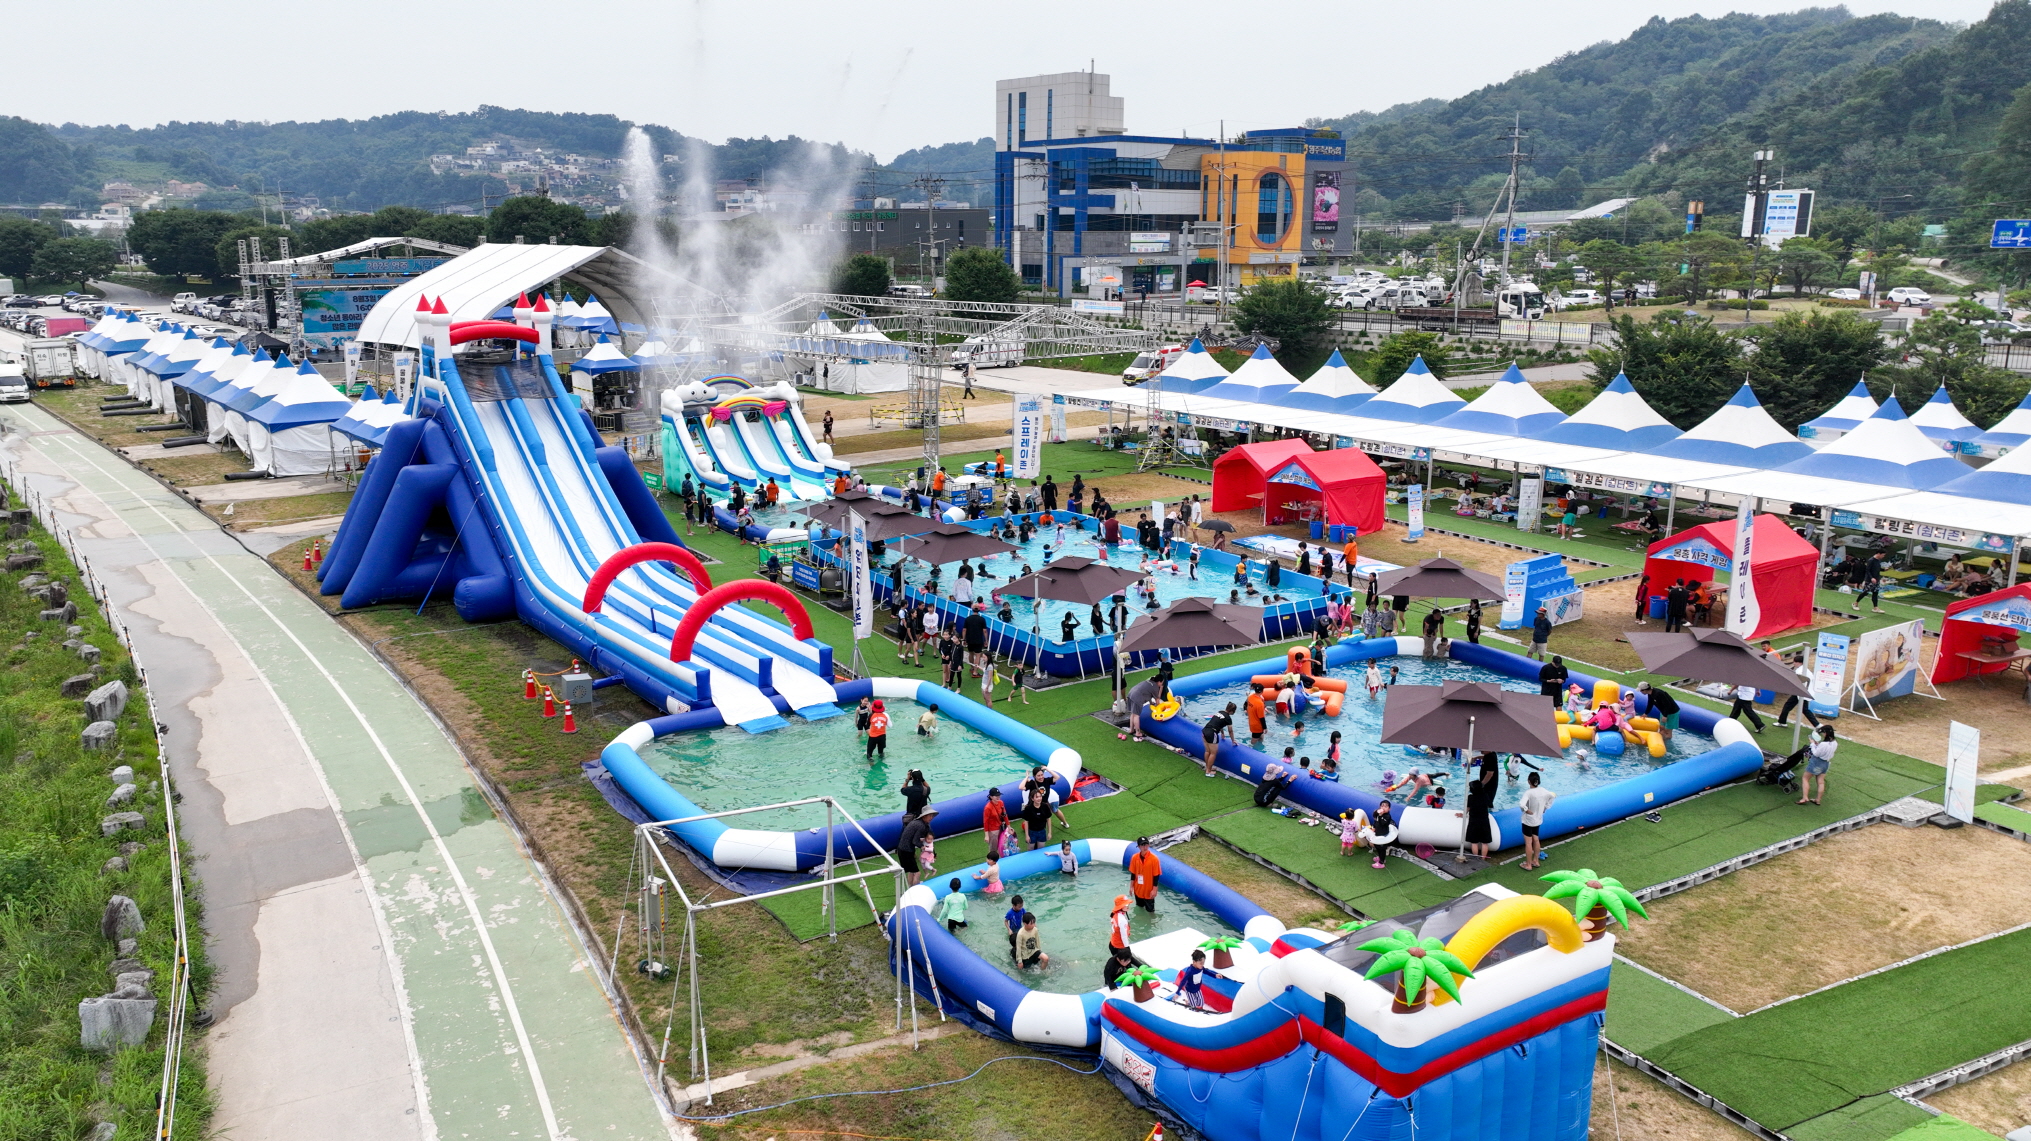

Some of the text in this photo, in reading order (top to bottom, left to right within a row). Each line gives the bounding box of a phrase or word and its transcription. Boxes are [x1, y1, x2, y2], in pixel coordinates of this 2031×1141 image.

[320, 314, 341, 322] 청소년
[1019, 416, 1031, 470] 스프레이존
[1673, 548, 1728, 568] 물총 사격 게임
[1982, 610, 2009, 622] 물풍선
